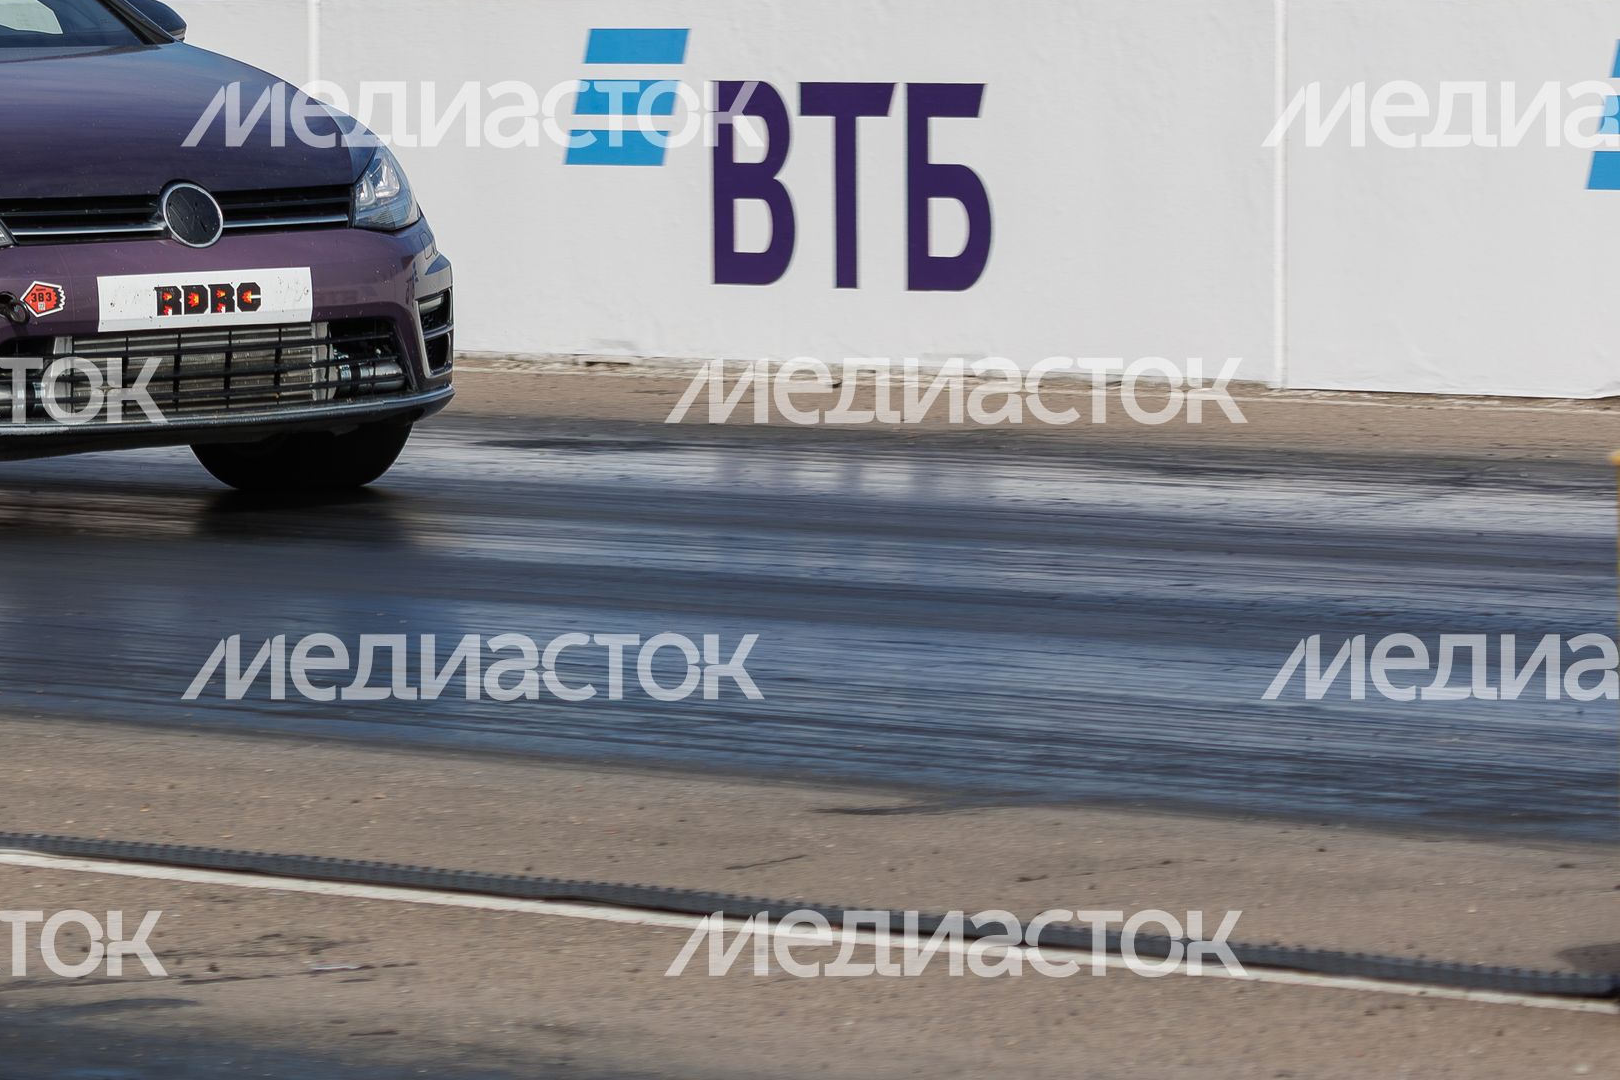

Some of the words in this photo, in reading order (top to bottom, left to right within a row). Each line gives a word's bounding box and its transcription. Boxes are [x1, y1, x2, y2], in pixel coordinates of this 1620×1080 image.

[711, 80, 994, 293] ВТБ
[30, 292, 52, 302] 383
[154, 281, 262, 317] RDRC
